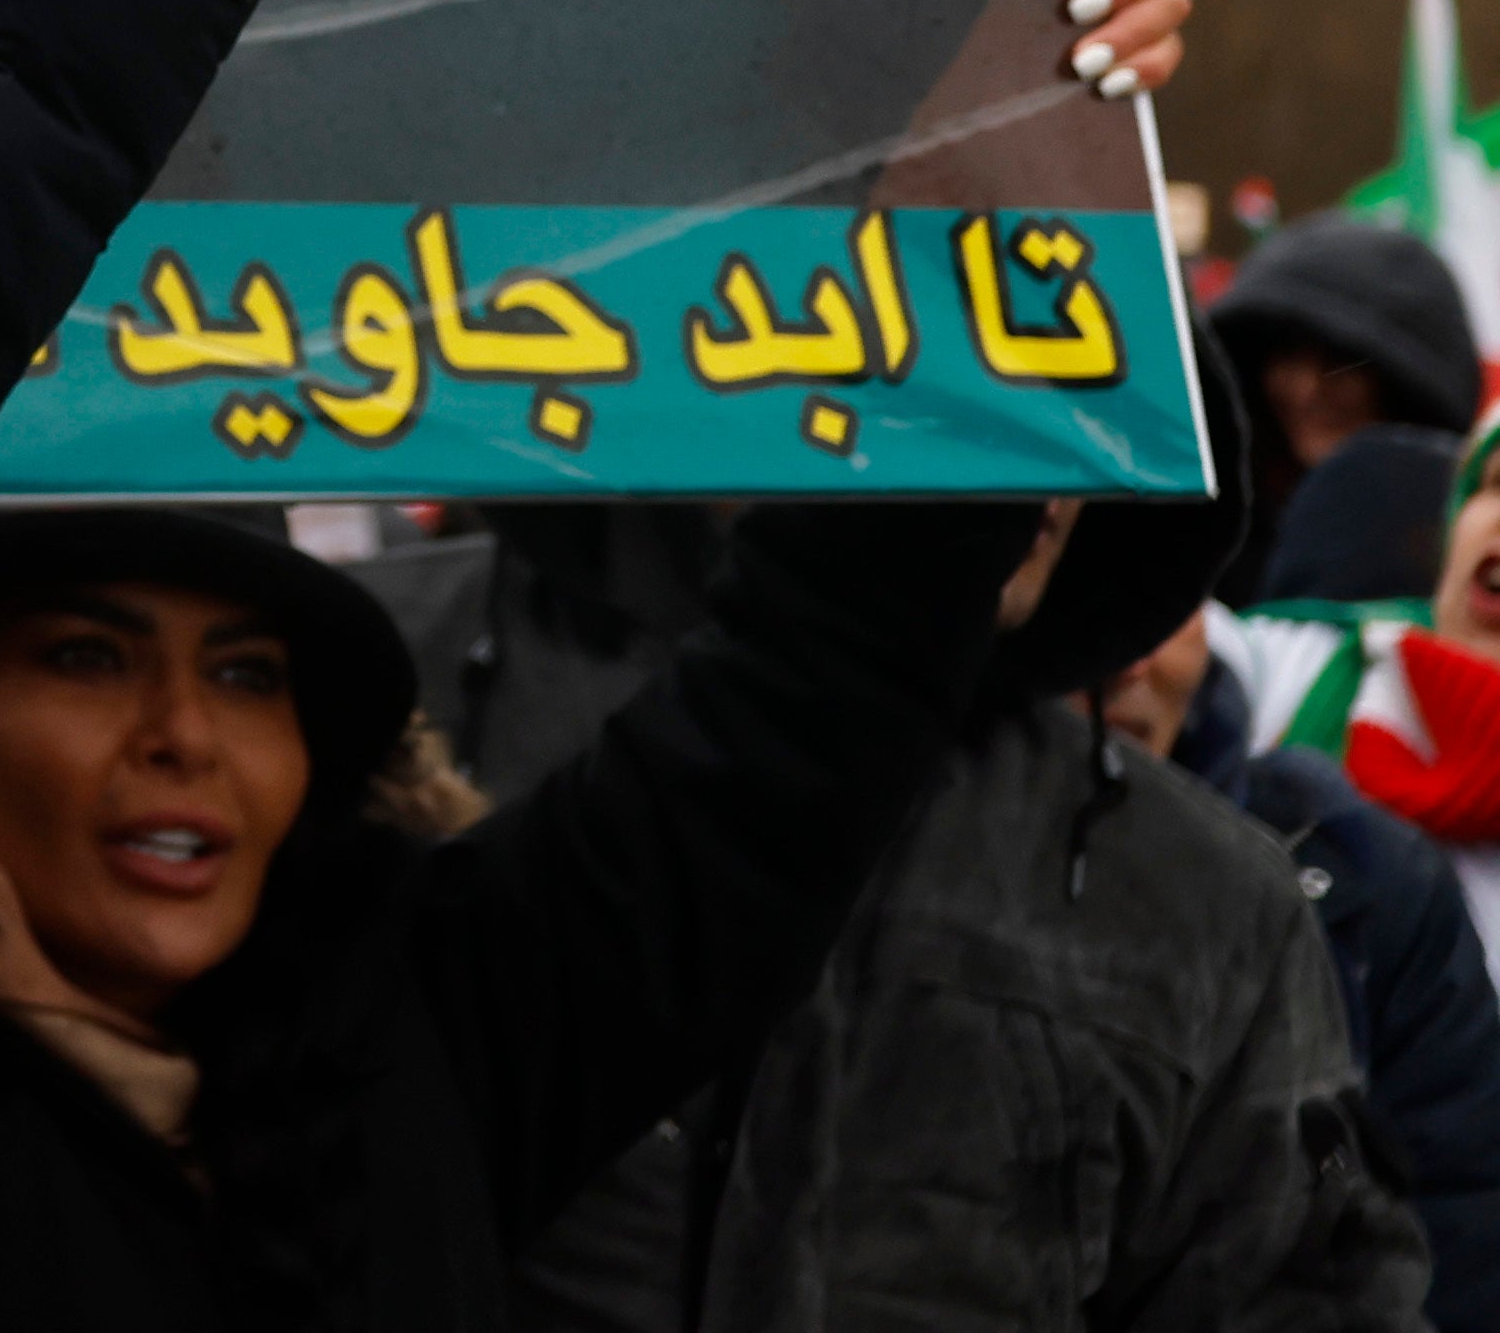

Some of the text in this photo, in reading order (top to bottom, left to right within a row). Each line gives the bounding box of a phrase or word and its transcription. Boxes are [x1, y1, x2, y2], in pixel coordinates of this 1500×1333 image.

[110, 209, 1126, 457] تا ابد جاوید
